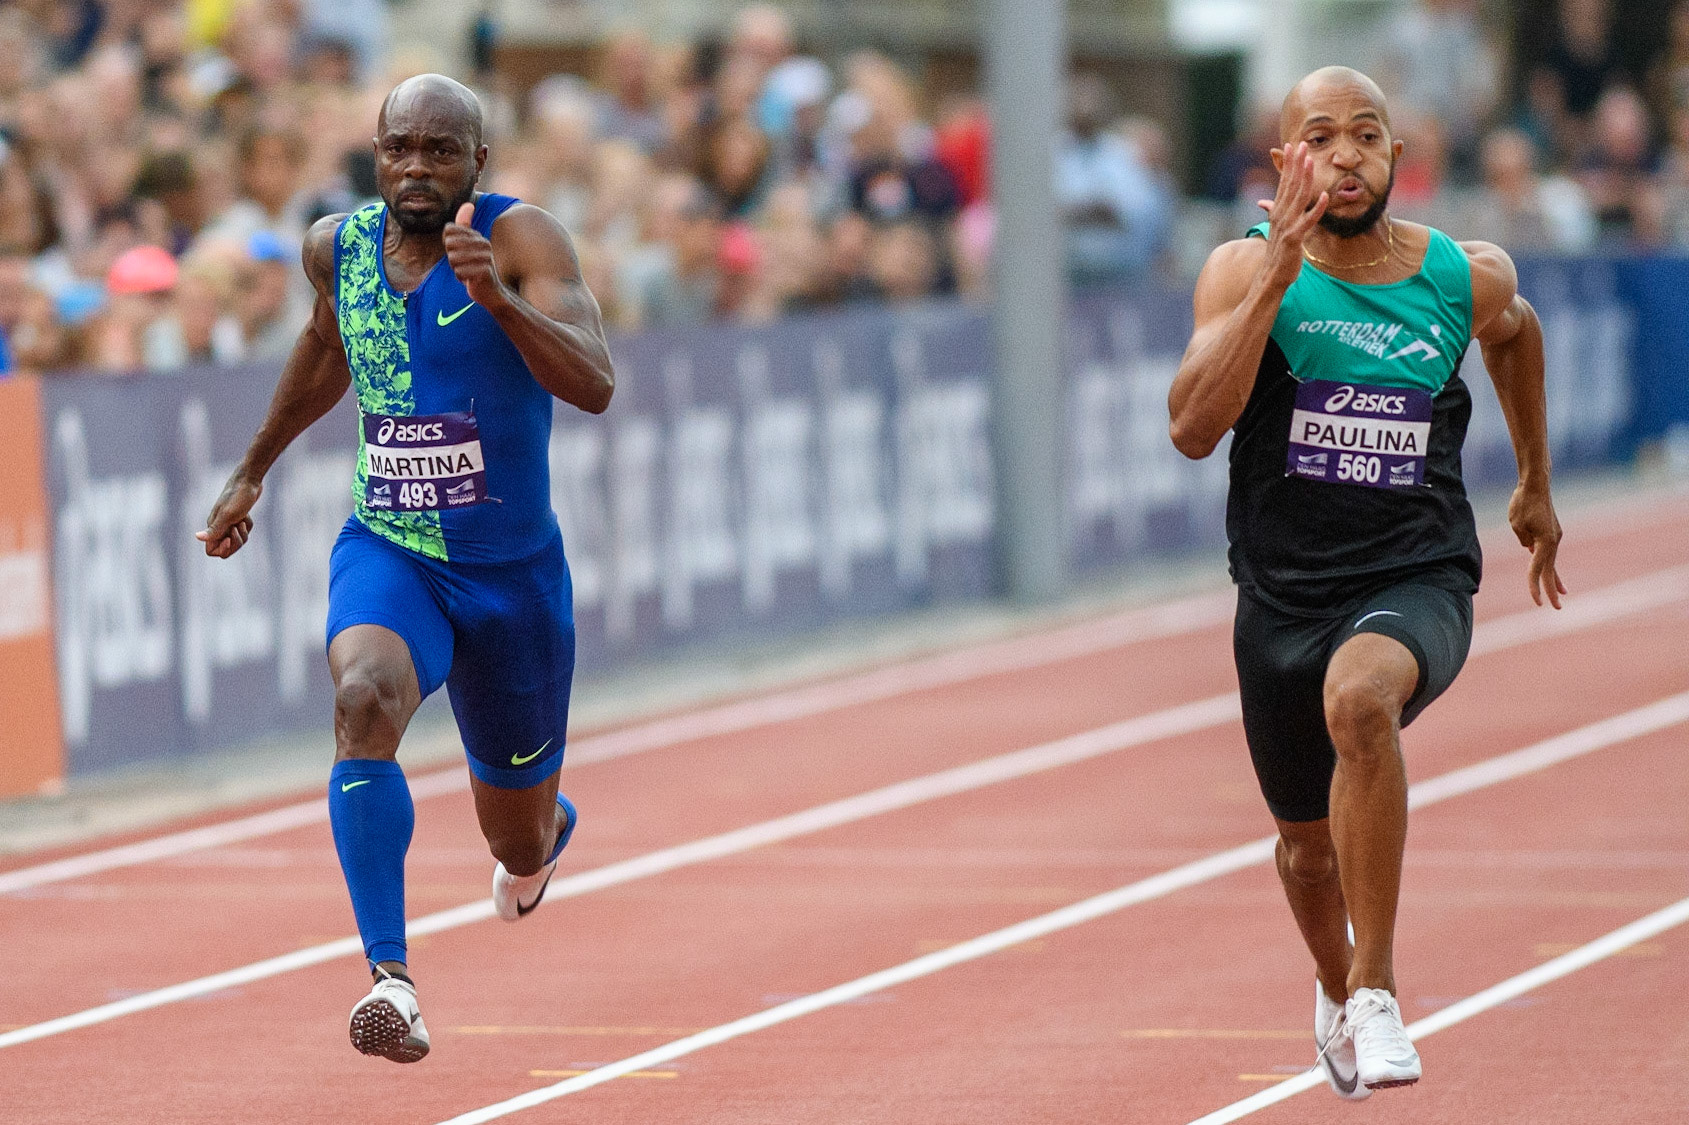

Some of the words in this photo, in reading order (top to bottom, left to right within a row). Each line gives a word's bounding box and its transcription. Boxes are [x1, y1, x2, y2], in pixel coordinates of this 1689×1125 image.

[1296, 320, 1403, 344] ROTTERDAM
[1338, 336, 1389, 359] ATLETIEK
[1351, 393, 1406, 414] asics
[395, 422, 443, 441] asics
[1303, 421, 1417, 452] PAULINA
[370, 453, 474, 476] MARTINA
[1336, 453, 1381, 484] 560
[399, 481, 438, 508] 493
